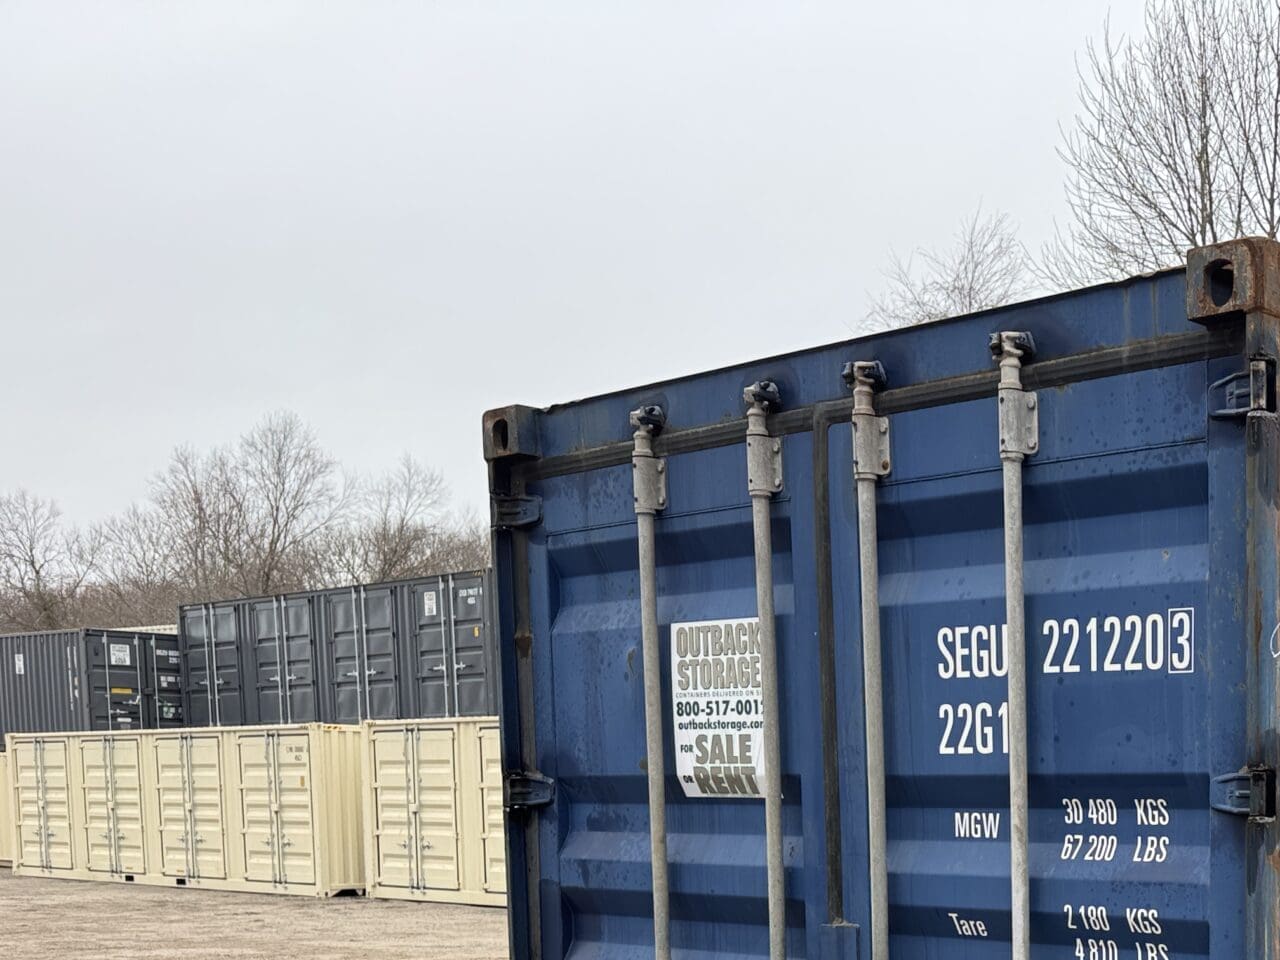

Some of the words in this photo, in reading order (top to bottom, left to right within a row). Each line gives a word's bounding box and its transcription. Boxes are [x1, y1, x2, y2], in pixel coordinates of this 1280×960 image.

[675, 621, 761, 658] OUTBACK
[937, 624, 1008, 679] SEGU
[677, 656, 761, 690] STORAGE
[712, 690, 743, 698] DELIVERED
[939, 702, 1009, 755] 22G1
[680, 744, 694, 753] FOR
[695, 734, 752, 765] SALE
[683, 775, 694, 783] OR
[693, 766, 760, 795] RENT
[954, 812, 1000, 838] MGW
[1133, 799, 1169, 825] KGS
[1133, 836, 1169, 862] LBS
[948, 913, 988, 937] Tare
[1126, 908, 1162, 935] KGS
